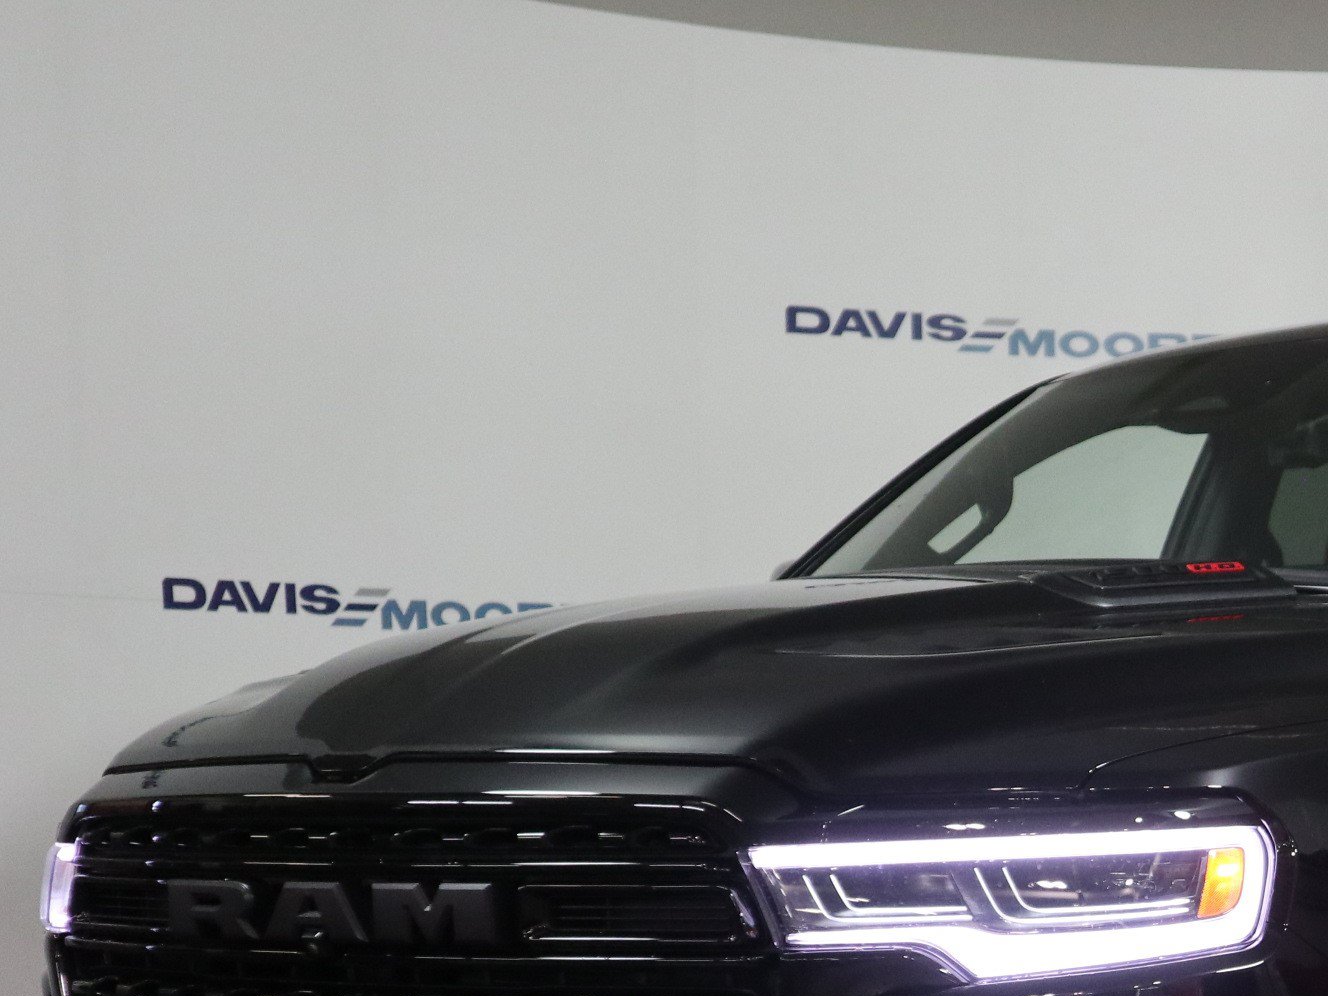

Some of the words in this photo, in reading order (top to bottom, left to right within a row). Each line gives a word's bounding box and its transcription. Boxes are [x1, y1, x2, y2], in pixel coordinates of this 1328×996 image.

[785, 305, 968, 342] DAVIS
[162, 577, 341, 616] DAVIS
[166, 879, 495, 943] RAM
